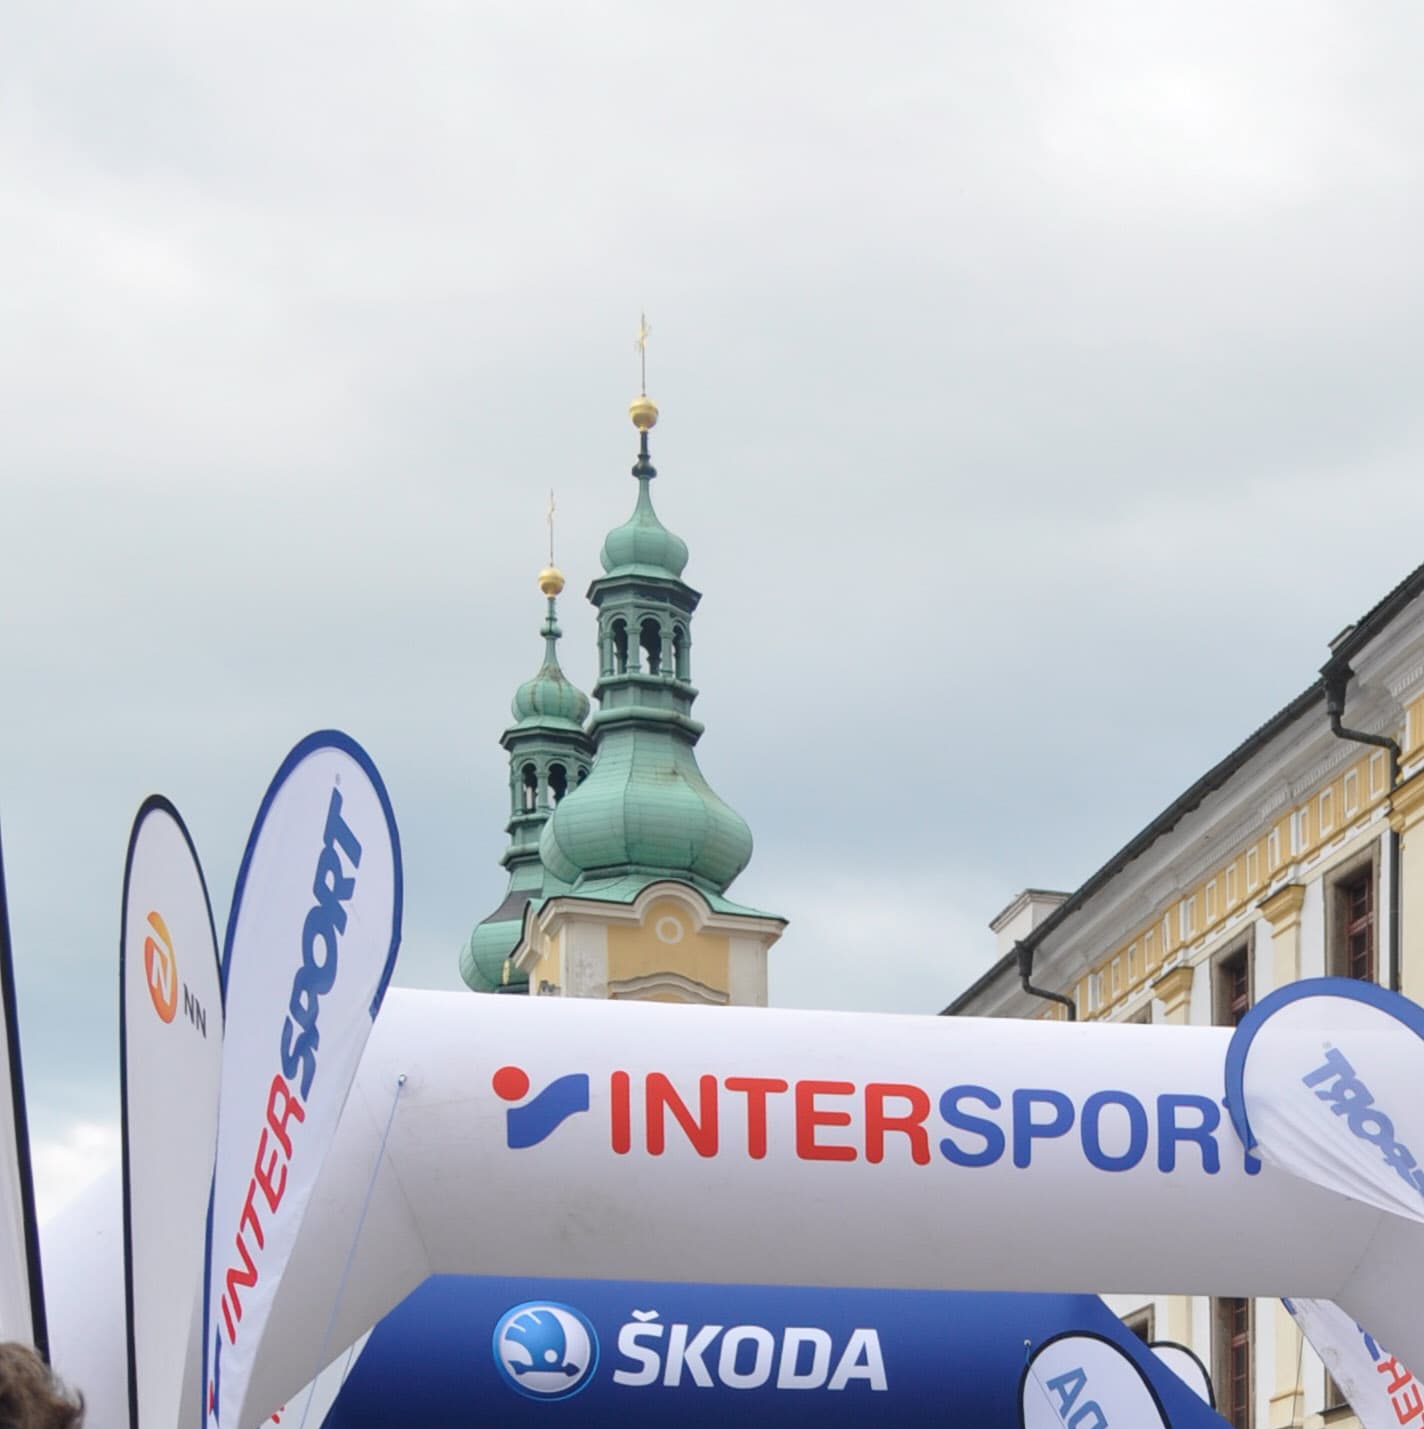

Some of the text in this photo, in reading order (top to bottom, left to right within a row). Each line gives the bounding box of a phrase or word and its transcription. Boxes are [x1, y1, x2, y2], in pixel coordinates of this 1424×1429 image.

[183, 983, 207, 1039] NN
[221, 788, 362, 1345] INTERSPORT
[612, 1309, 888, 1393] ŠKODA
